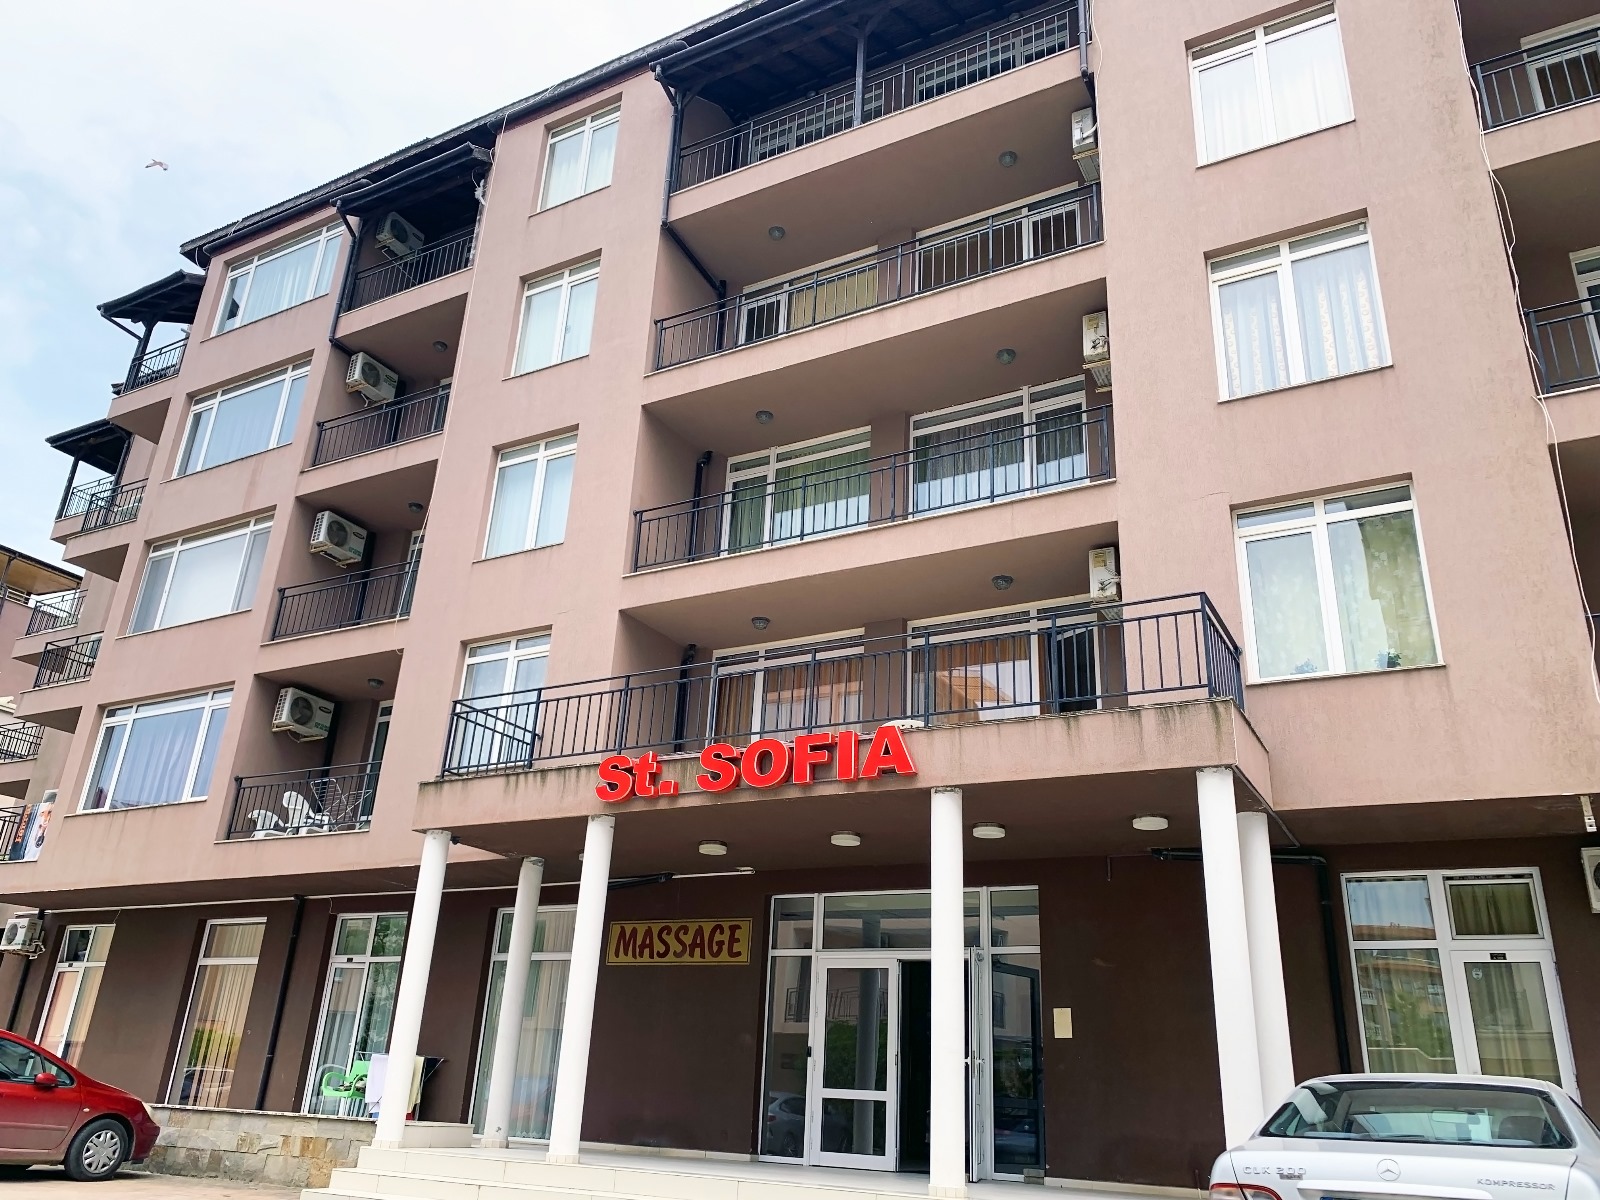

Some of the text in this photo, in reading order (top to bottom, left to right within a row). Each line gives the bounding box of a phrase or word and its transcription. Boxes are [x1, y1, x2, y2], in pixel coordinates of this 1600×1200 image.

[595, 725, 917, 803] St. SOFIA
[614, 923, 742, 960] MASSAGE
[1243, 1166, 1307, 1175] CLK 200
[1476, 1178, 1556, 1191] KOMPRESSOR
